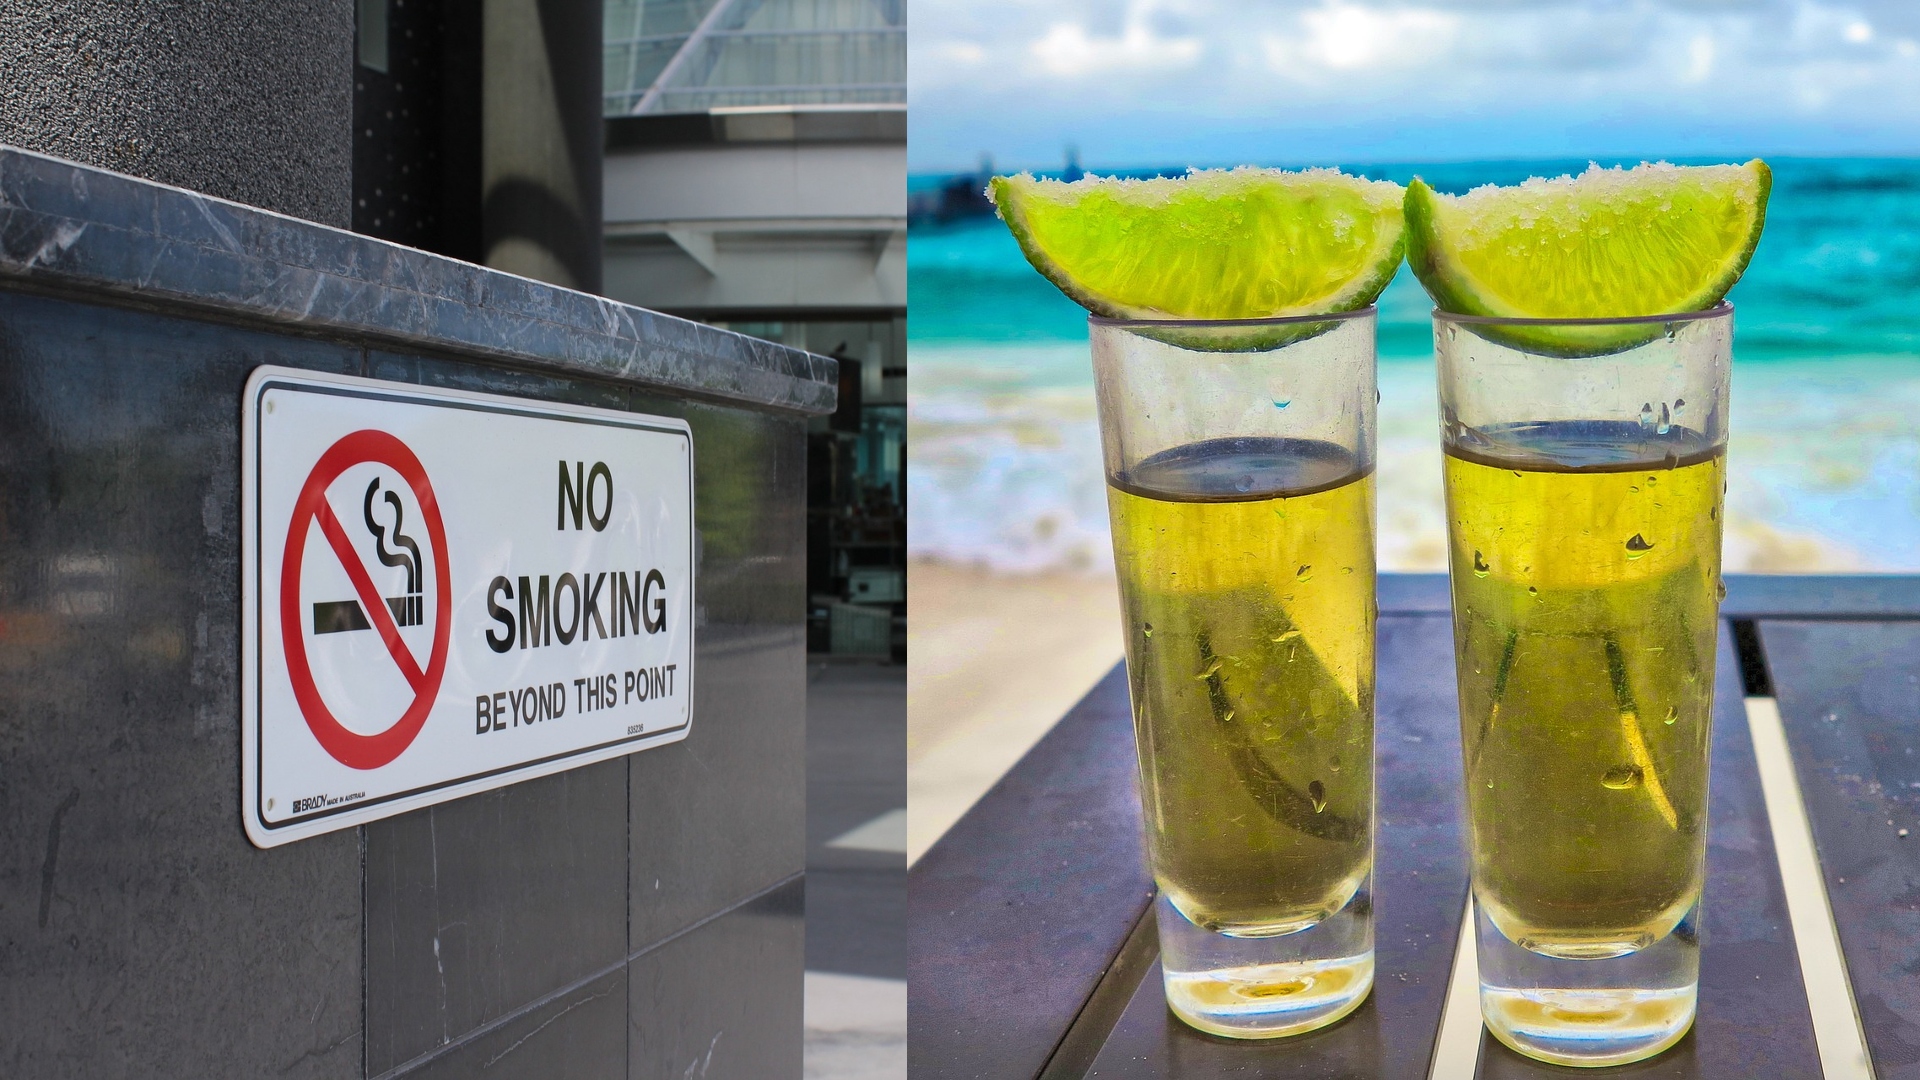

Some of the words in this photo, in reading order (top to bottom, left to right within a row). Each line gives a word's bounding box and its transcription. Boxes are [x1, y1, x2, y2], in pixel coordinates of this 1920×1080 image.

[558, 460, 613, 532] NO
[485, 569, 666, 653] SMOKING
[476, 682, 566, 735] BEYOND
[574, 673, 617, 714] THIS
[624, 664, 677, 705] POINT
[302, 794, 327, 811] BRADY
[327, 797, 338, 805] MADE
[345, 791, 366, 801] AUSTRALIA
